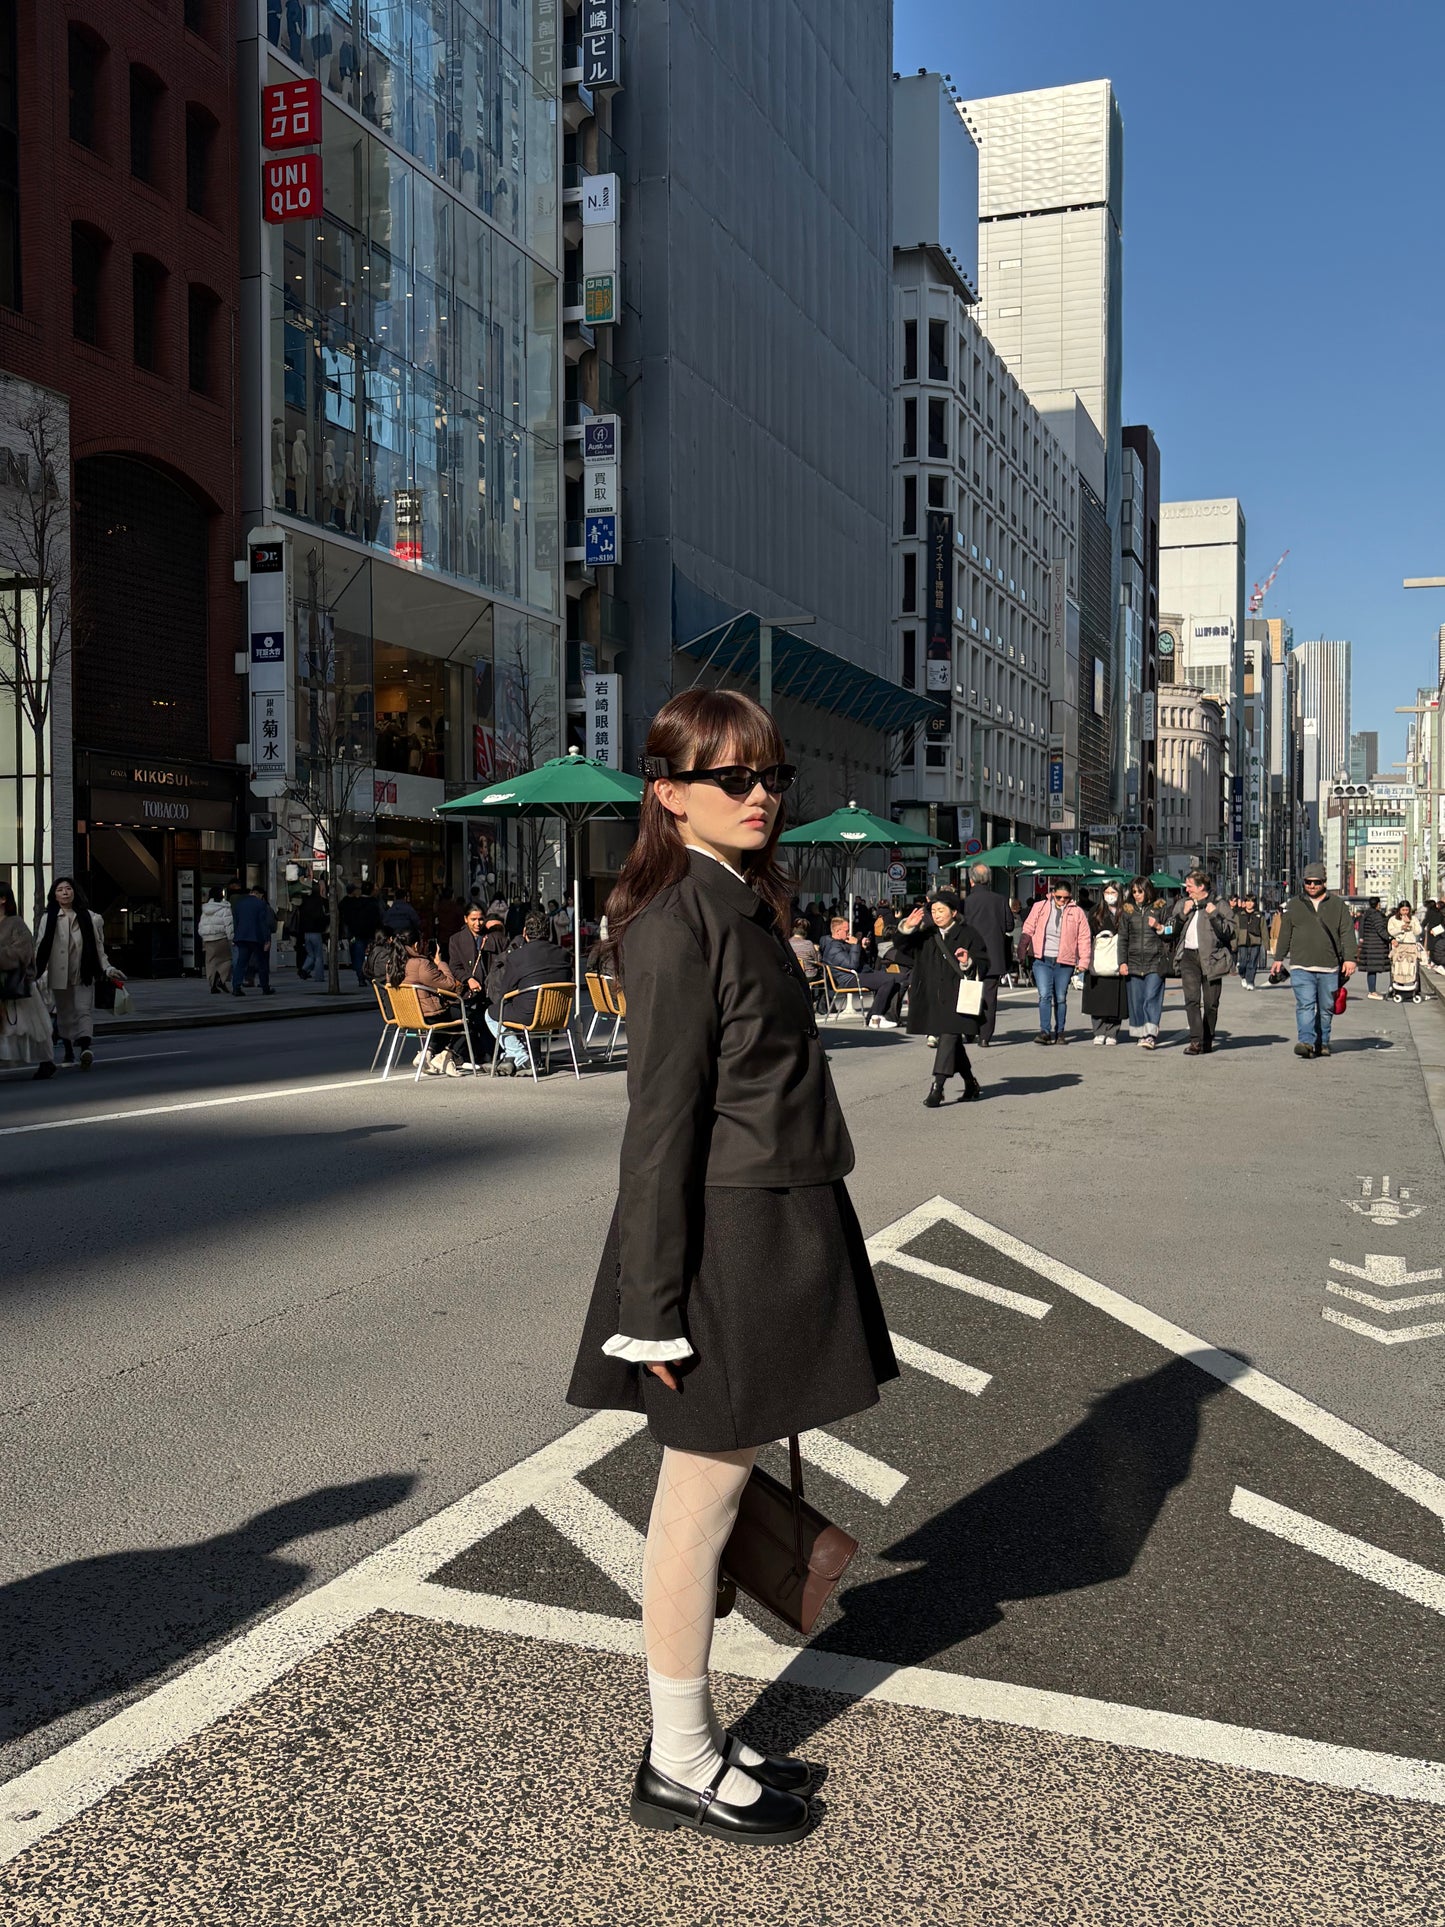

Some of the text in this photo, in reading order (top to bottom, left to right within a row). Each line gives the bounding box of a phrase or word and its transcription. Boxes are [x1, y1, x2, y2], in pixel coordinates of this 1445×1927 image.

[589, 0, 607, 81] 崎ビル
[271, 86, 309, 112] ユニ
[270, 112, 309, 138] クロ
[270, 162, 307, 188] UNI
[271, 187, 311, 215] QLO
[593, 472, 607, 500] 買取
[1159, 504, 1231, 520] MIKIMOTO
[595, 681, 609, 762] 岩崎眼鏡店
[932, 719, 946, 730] 6F
[262, 719, 279, 760] 菊水
[142, 800, 189, 819] TOBACCO
